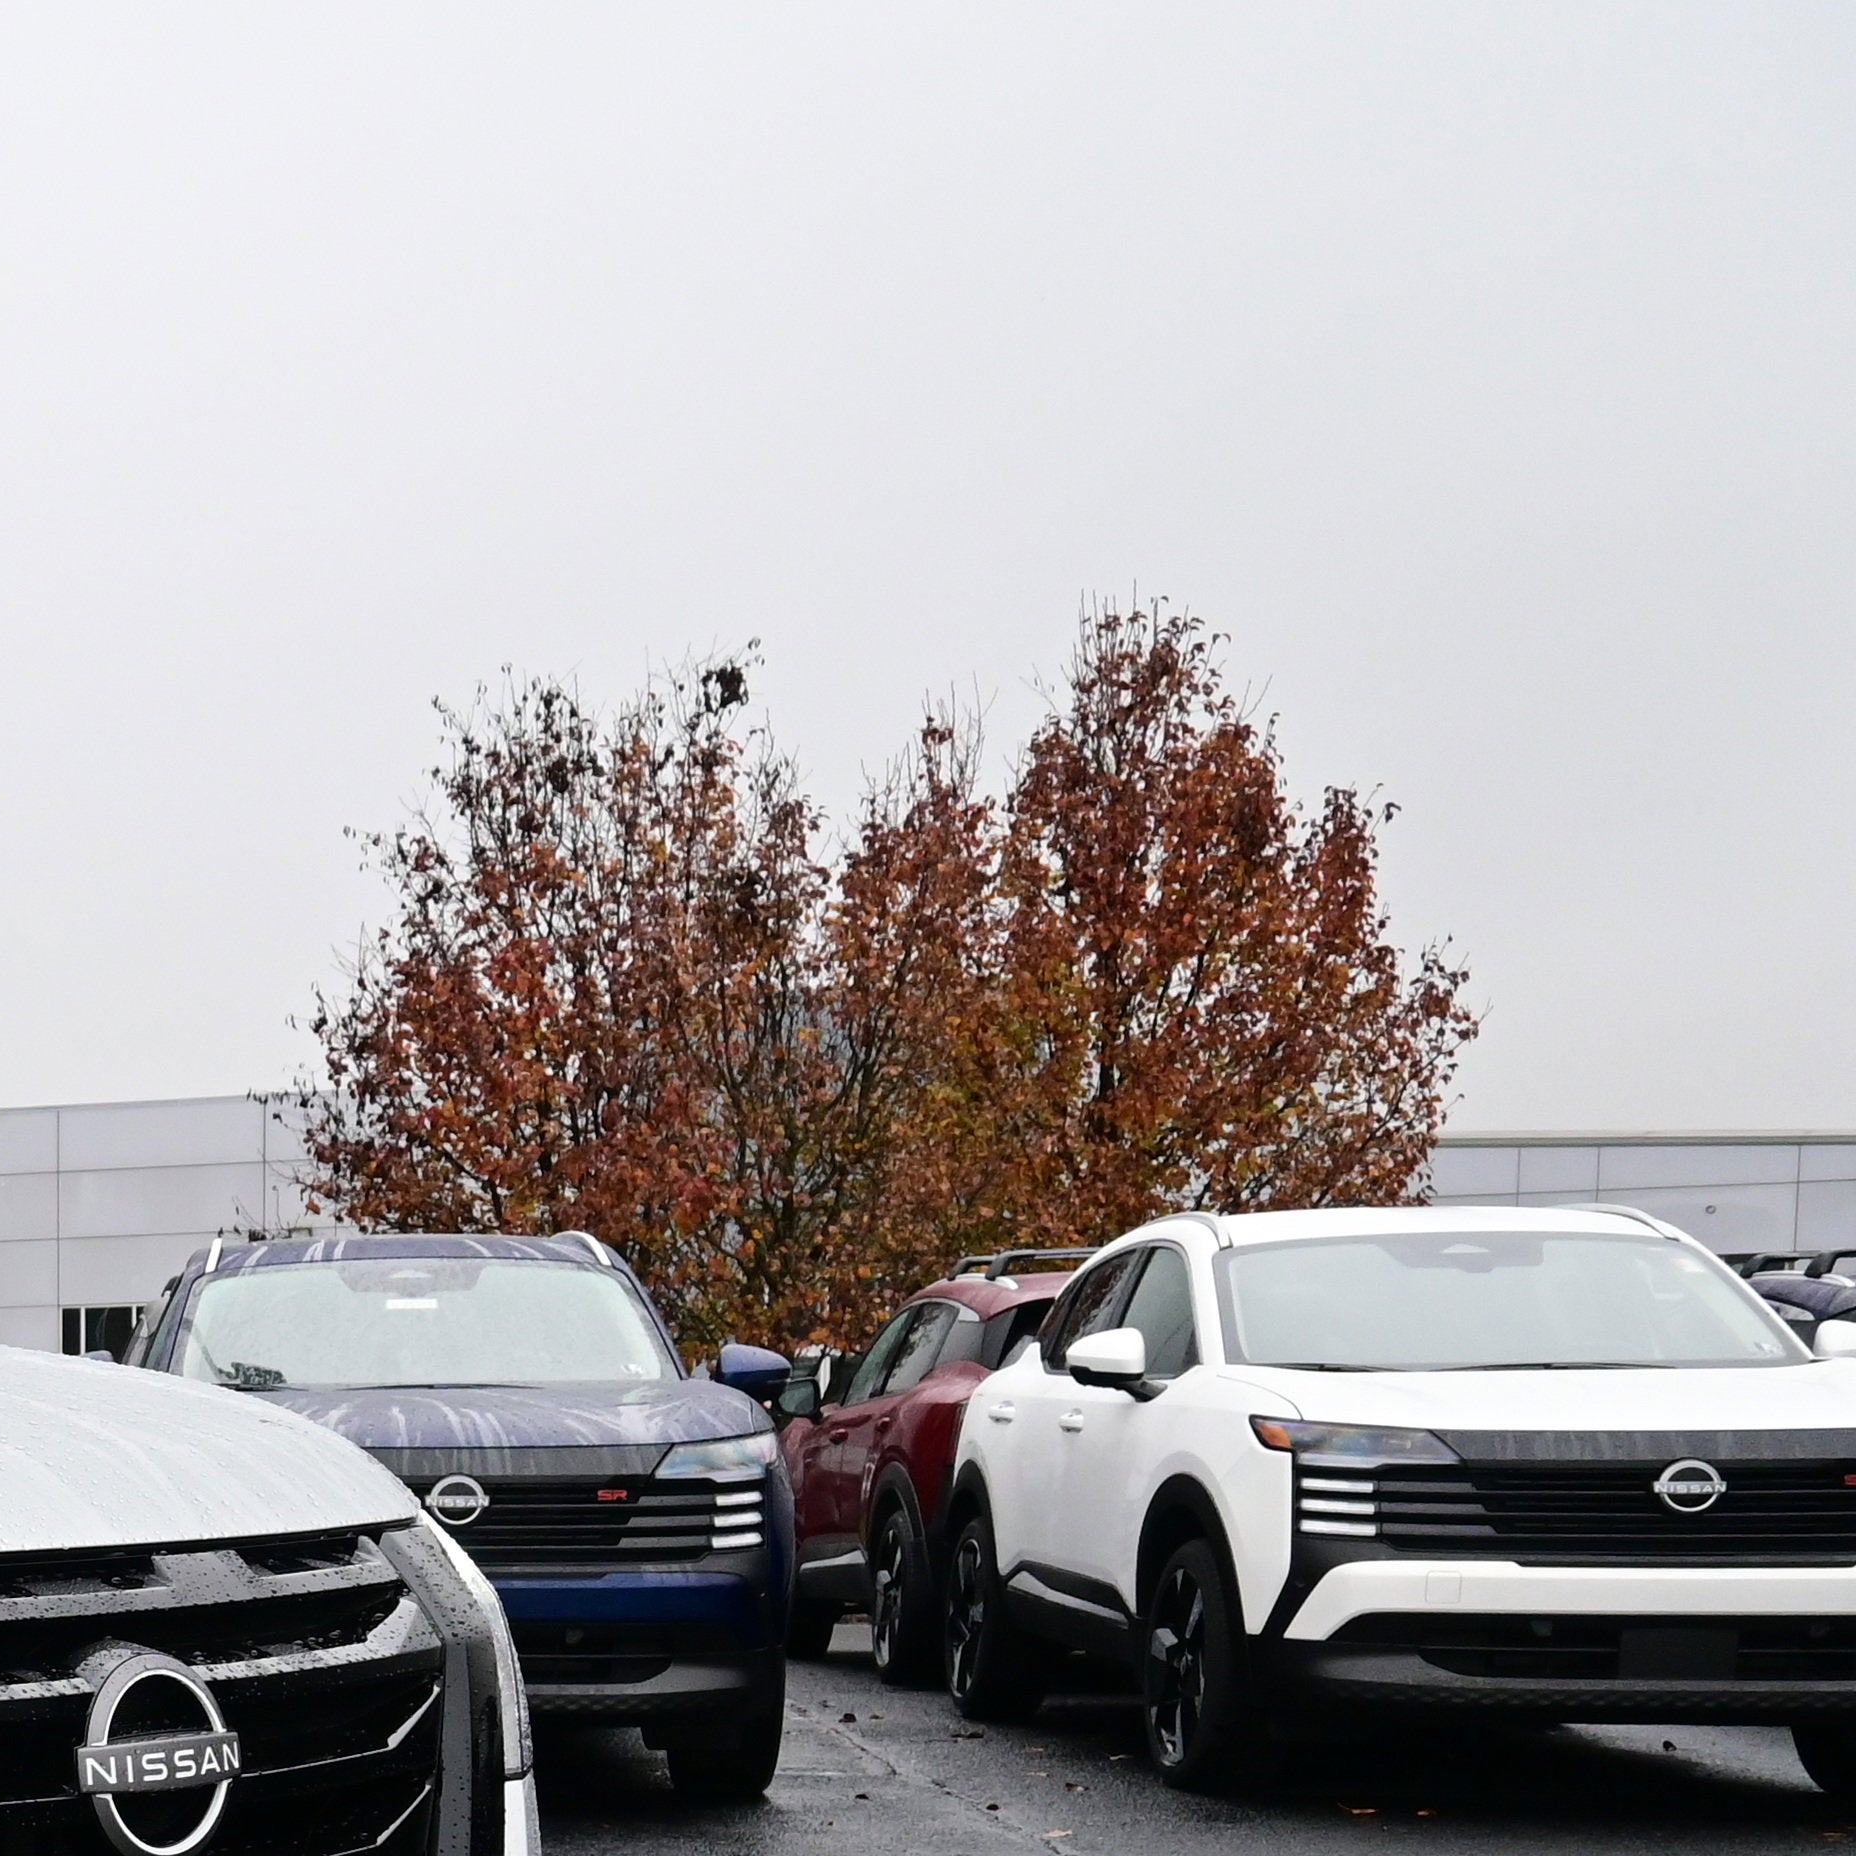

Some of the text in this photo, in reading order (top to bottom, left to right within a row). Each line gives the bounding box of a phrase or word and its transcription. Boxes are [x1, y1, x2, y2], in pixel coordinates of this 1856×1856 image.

[1654, 1483, 1727, 1494] NISSAN
[596, 1489, 628, 1501] SR
[426, 1497, 490, 1508] NISSAN
[85, 1740, 240, 1786] NISSAN
